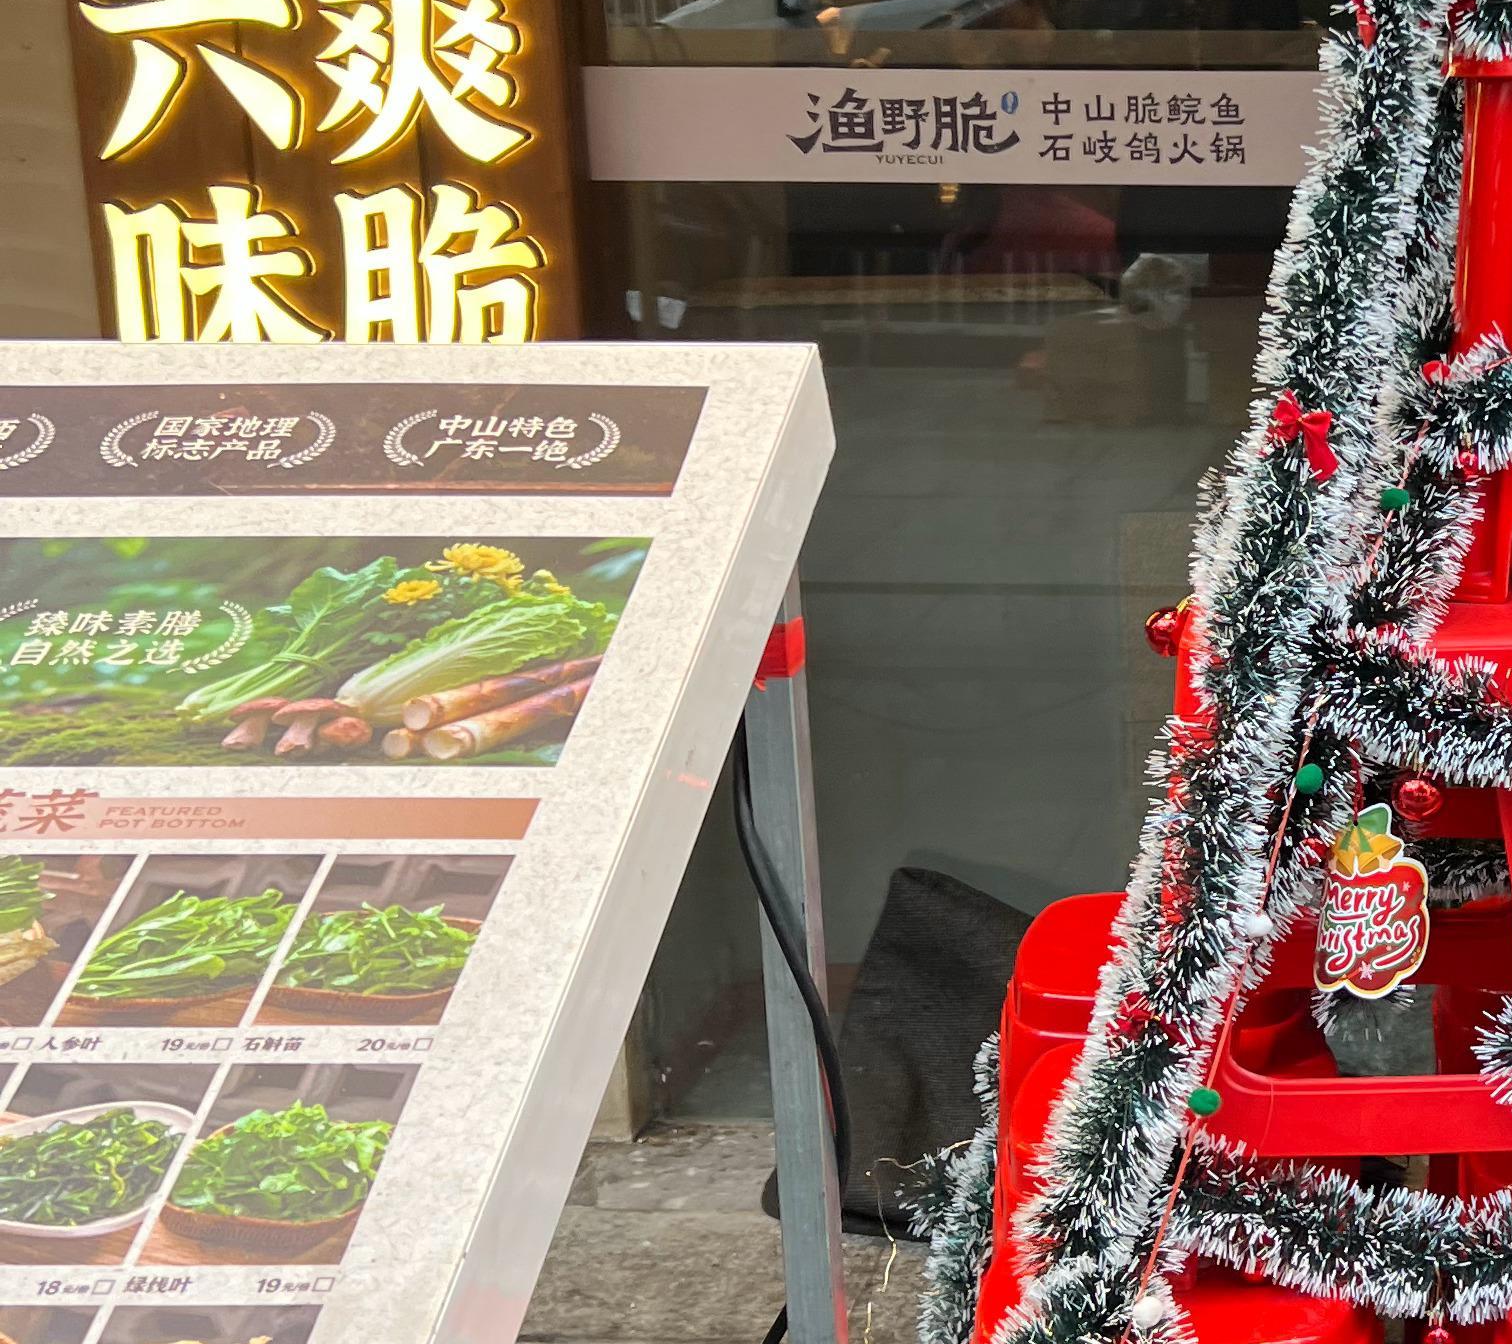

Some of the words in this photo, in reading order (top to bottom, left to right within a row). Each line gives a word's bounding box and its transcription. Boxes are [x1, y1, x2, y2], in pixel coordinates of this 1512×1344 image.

[786, 87, 1020, 155] 渔野脆
[1038, 91, 1247, 127] 中山脆鲩鱼
[875, 154, 945, 165] YUYECUI
[1037, 130, 1247, 166] 石岐鸽火锅
[153, 416, 300, 438] 国家地理
[438, 414, 578, 439] 中山特色
[140, 439, 282, 461] 标志产品
[424, 437, 569, 463] 广东一绝
[23, 609, 203, 637] 臻味素膳
[9, 639, 185, 666] 自然之选
[98, 818, 146, 830] POT
[150, 818, 246, 830] BOTTOM
[104, 806, 222, 817] FEATURED
